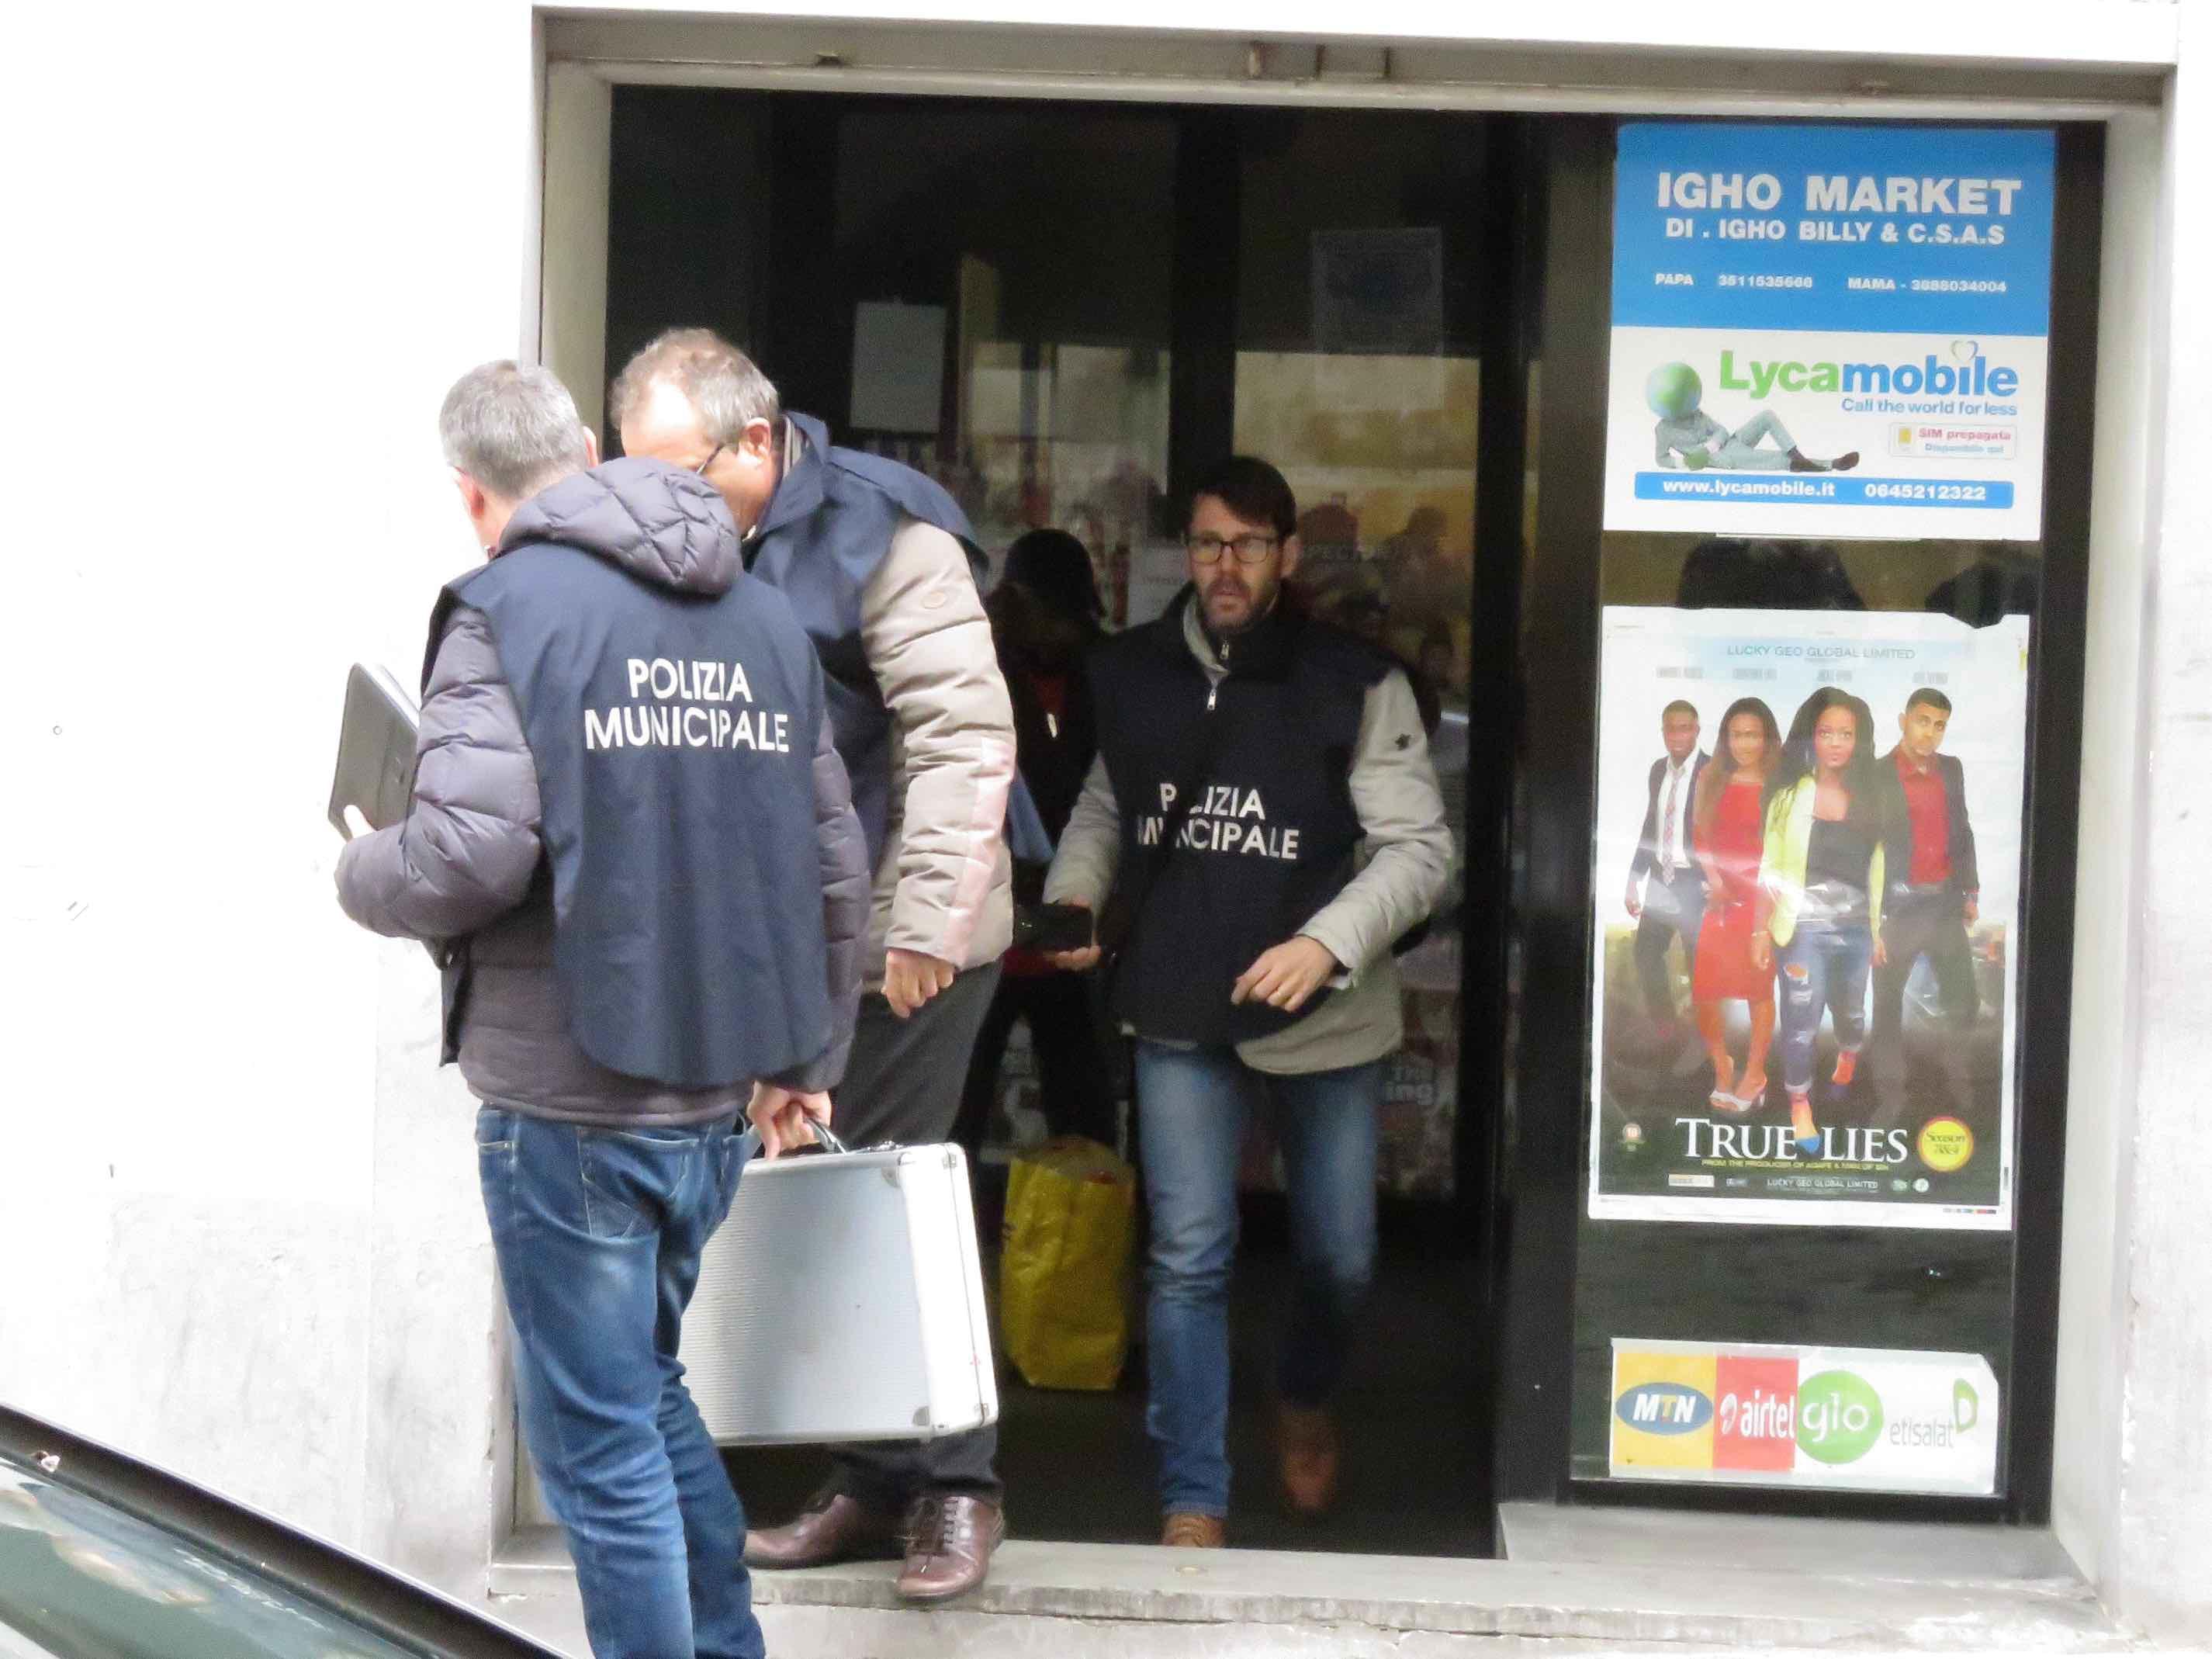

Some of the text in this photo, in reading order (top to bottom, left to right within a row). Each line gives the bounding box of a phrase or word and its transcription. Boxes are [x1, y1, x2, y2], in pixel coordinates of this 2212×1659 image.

[1657, 171, 2022, 216] IGHO MARKET
[1666, 217, 1694, 238] DI
[1719, 218, 1786, 240] IGHO
[1798, 220, 1873, 242] BILLY
[1880, 222, 1899, 243] &
[1907, 222, 2006, 244] C.S.A.S
[1655, 272, 1694, 286] PAPA
[1847, 276, 1896, 291] MAMA
[1719, 350, 2019, 400] Lycamobile
[1841, 397, 2018, 416] Call the world for less
[1918, 428, 2012, 442] SIM prepagata
[1663, 479, 1987, 501] www.lycamobile.it 0645212322
[1726, 645, 1916, 660] LUCKY GEO GLOBAL LIMITED
[627, 658, 753, 703] POLIZIA
[584, 705, 790, 753] MUNICIPALE
[1675, 1117, 1909, 1163] TRUE LIES
[1632, 1393, 1696, 1424] MTN
[1739, 1389, 1795, 1440] airtel
[1888, 1416, 1955, 1449] etisalat
